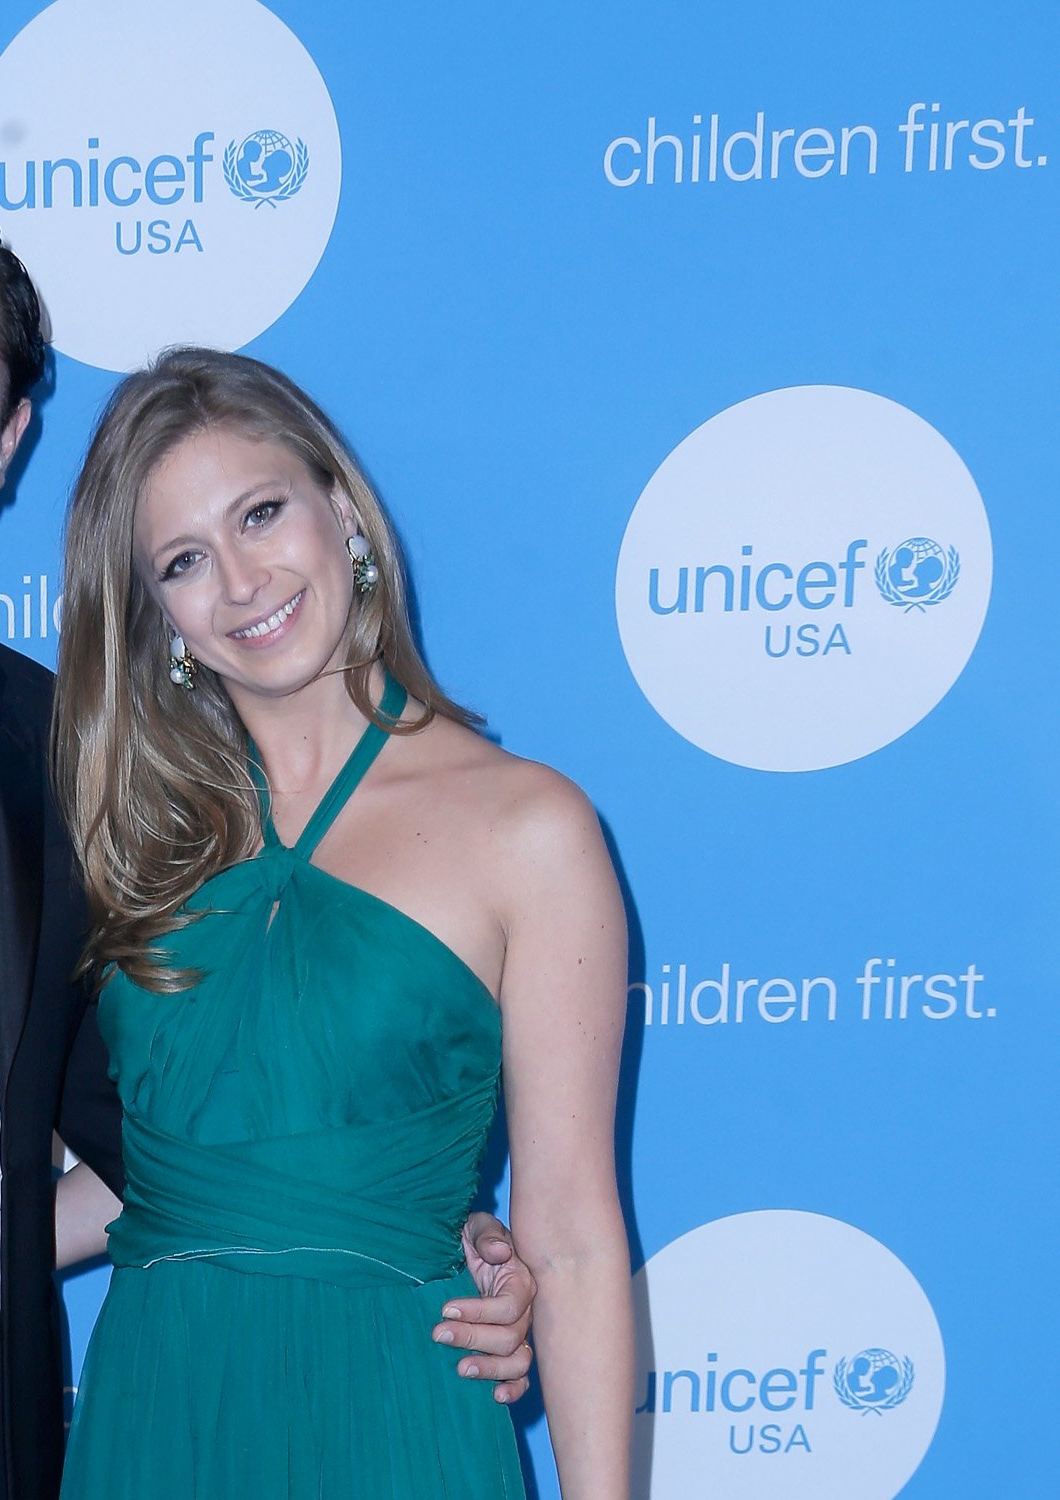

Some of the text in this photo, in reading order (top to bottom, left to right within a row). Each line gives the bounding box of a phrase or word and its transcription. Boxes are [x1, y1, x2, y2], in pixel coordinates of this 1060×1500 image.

[603, 103, 1047, 187] children first.
[116, 220, 204, 255] USA
[649, 540, 867, 615] unicef
[764, 624, 851, 657] USA
[628, 958, 997, 1025] hildren first.
[729, 1424, 812, 1454] USA
